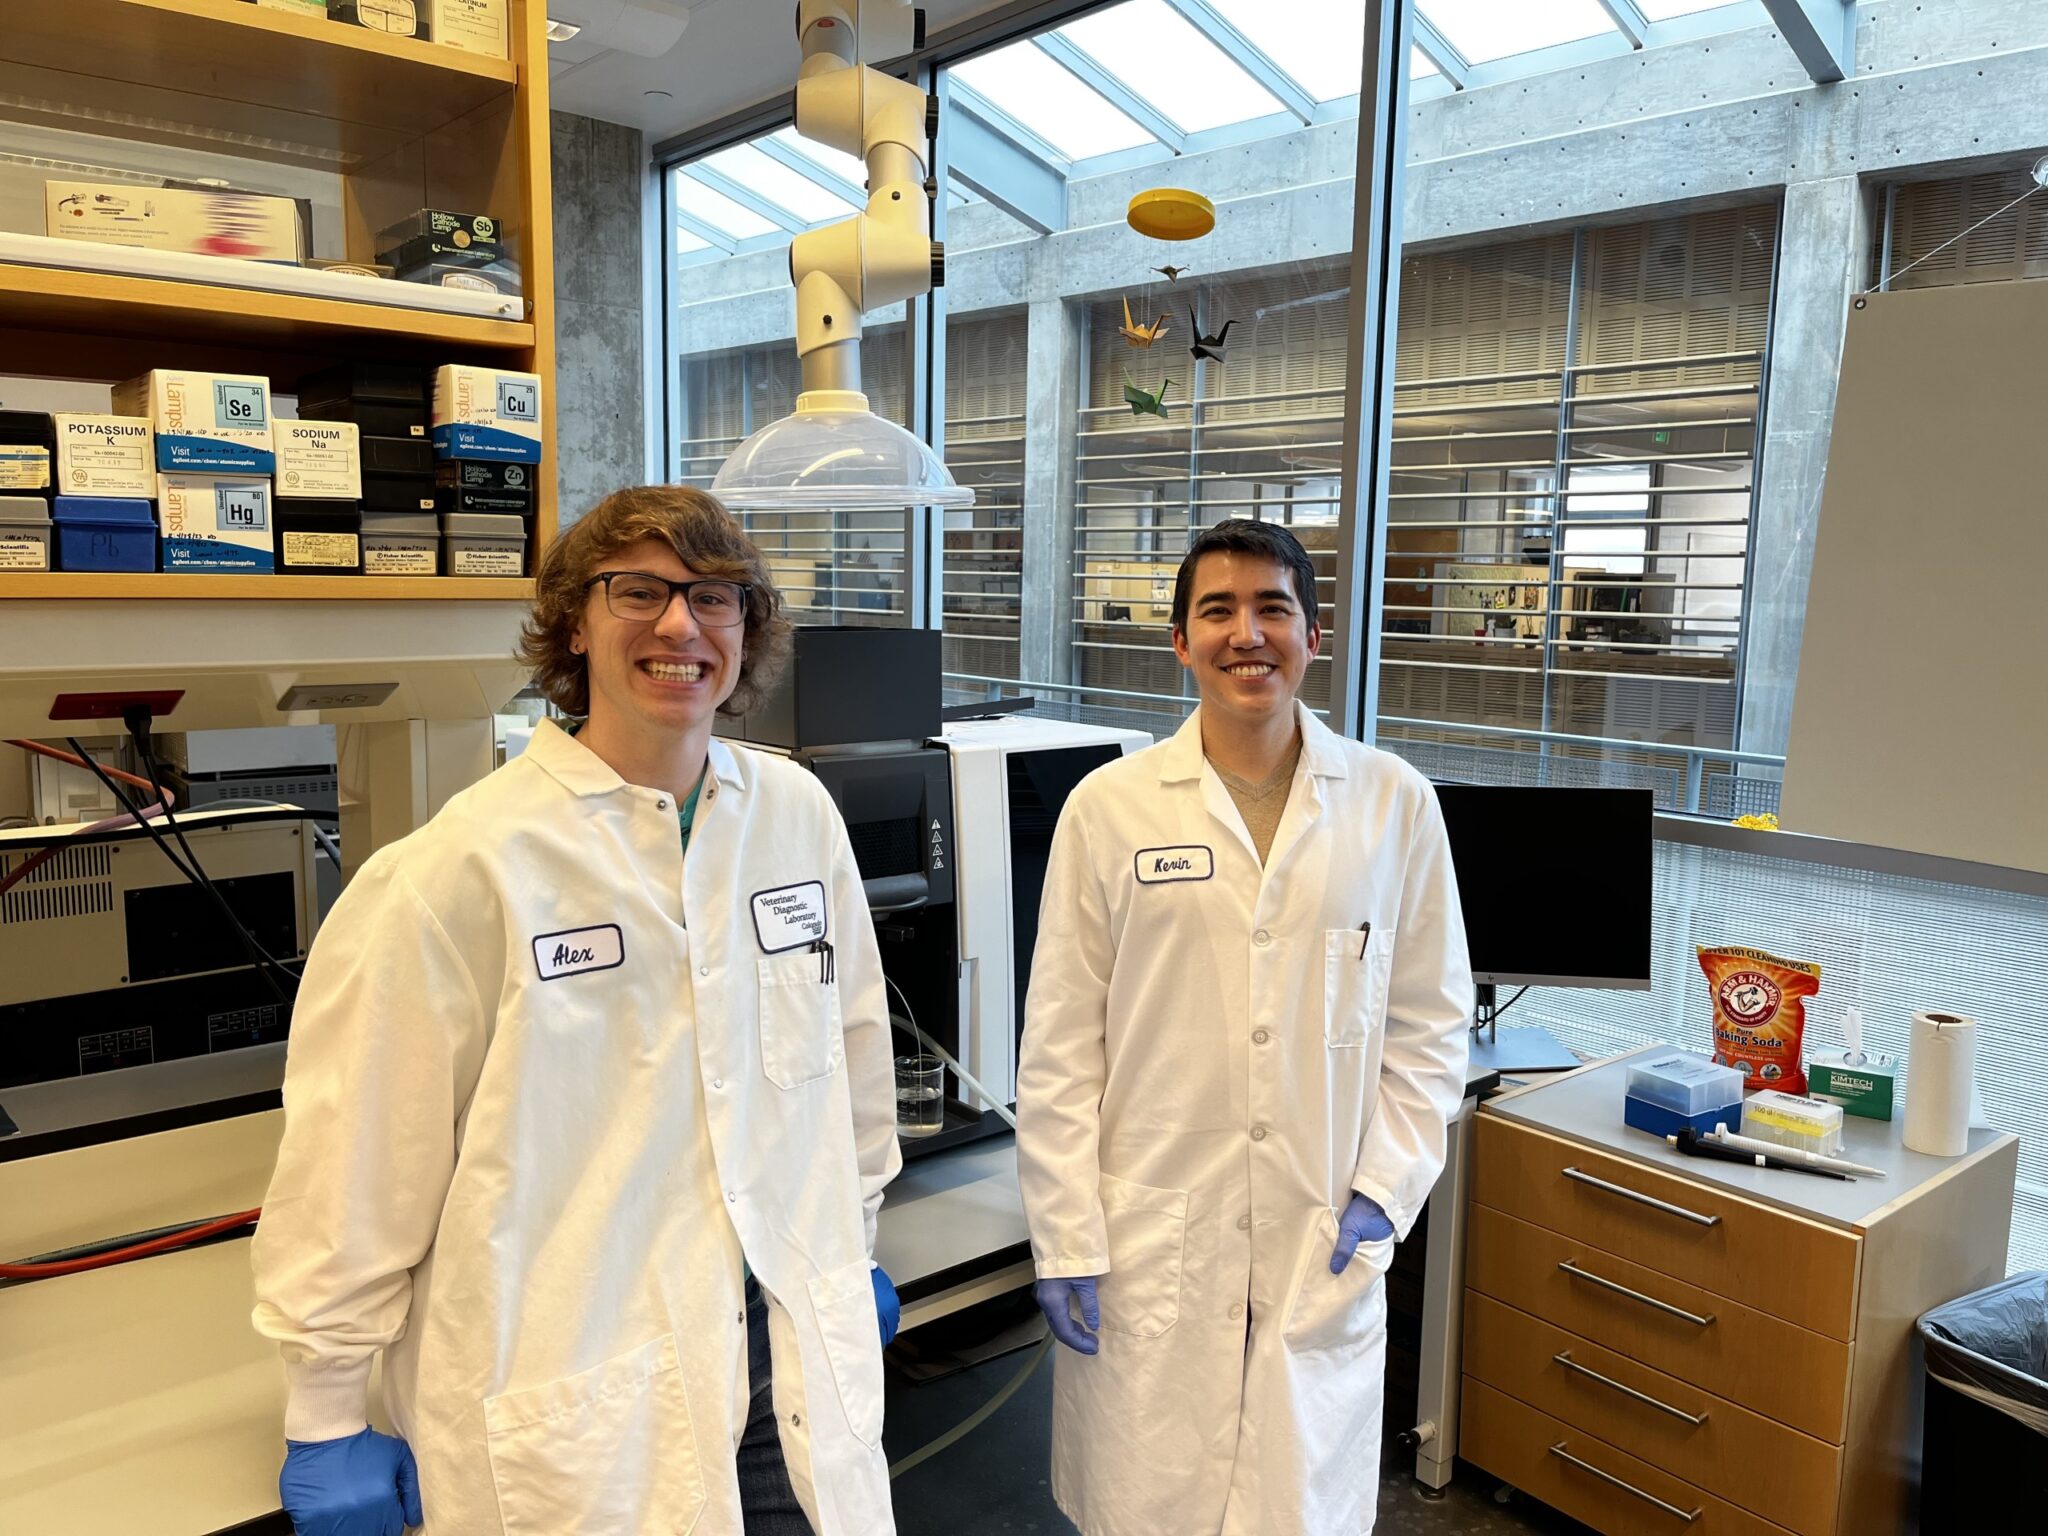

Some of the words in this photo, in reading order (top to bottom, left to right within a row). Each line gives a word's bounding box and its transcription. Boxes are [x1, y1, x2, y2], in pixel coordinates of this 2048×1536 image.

[432, 212, 455, 221] Hollow
[432, 218, 461, 228] Cathode
[432, 223, 452, 232] Lamp
[476, 221, 491, 232] Sb
[456, 376, 473, 418] Lamps
[164, 383, 184, 429] Lamps
[229, 399, 251, 417] Se
[507, 395, 526, 412] Cu
[68, 424, 146, 436] POTASSIUM
[292, 429, 340, 440] SODIUM
[107, 436, 115, 445] K
[311, 440, 326, 448] Na
[459, 433, 475, 443] Visit
[171, 446, 190, 456] Visit
[465, 465, 487, 473] Hollow
[465, 470, 493, 479] Cathode
[507, 469, 521, 480] Zn
[465, 474, 484, 483] Lamp
[165, 486, 186, 531] Lamps
[230, 504, 253, 524] Hg
[91, 533, 120, 558] Pb
[171, 549, 190, 558] Visit
[1154, 857, 1191, 872] Kevin
[760, 894, 797, 907] Veterinary
[773, 901, 808, 915] Diagnostic
[784, 912, 817, 925] Laboratory
[552, 943, 594, 967] Alex
[1704, 947, 1729, 955] OVER
[1731, 948, 1745, 957] 101
[1746, 950, 1789, 967] CLEANING
[1788, 961, 1811, 973] USES
[1721, 979, 1739, 1000] ARM
[1738, 975, 1747, 984] &
[1748, 974, 1778, 1007] HAMMER
[1715, 1027, 1748, 1046] Baking
[1752, 1036, 1782, 1047] Soda
[1736, 1027, 1753, 1035] Pure
[1831, 1075, 1873, 1088] KIMTECH
